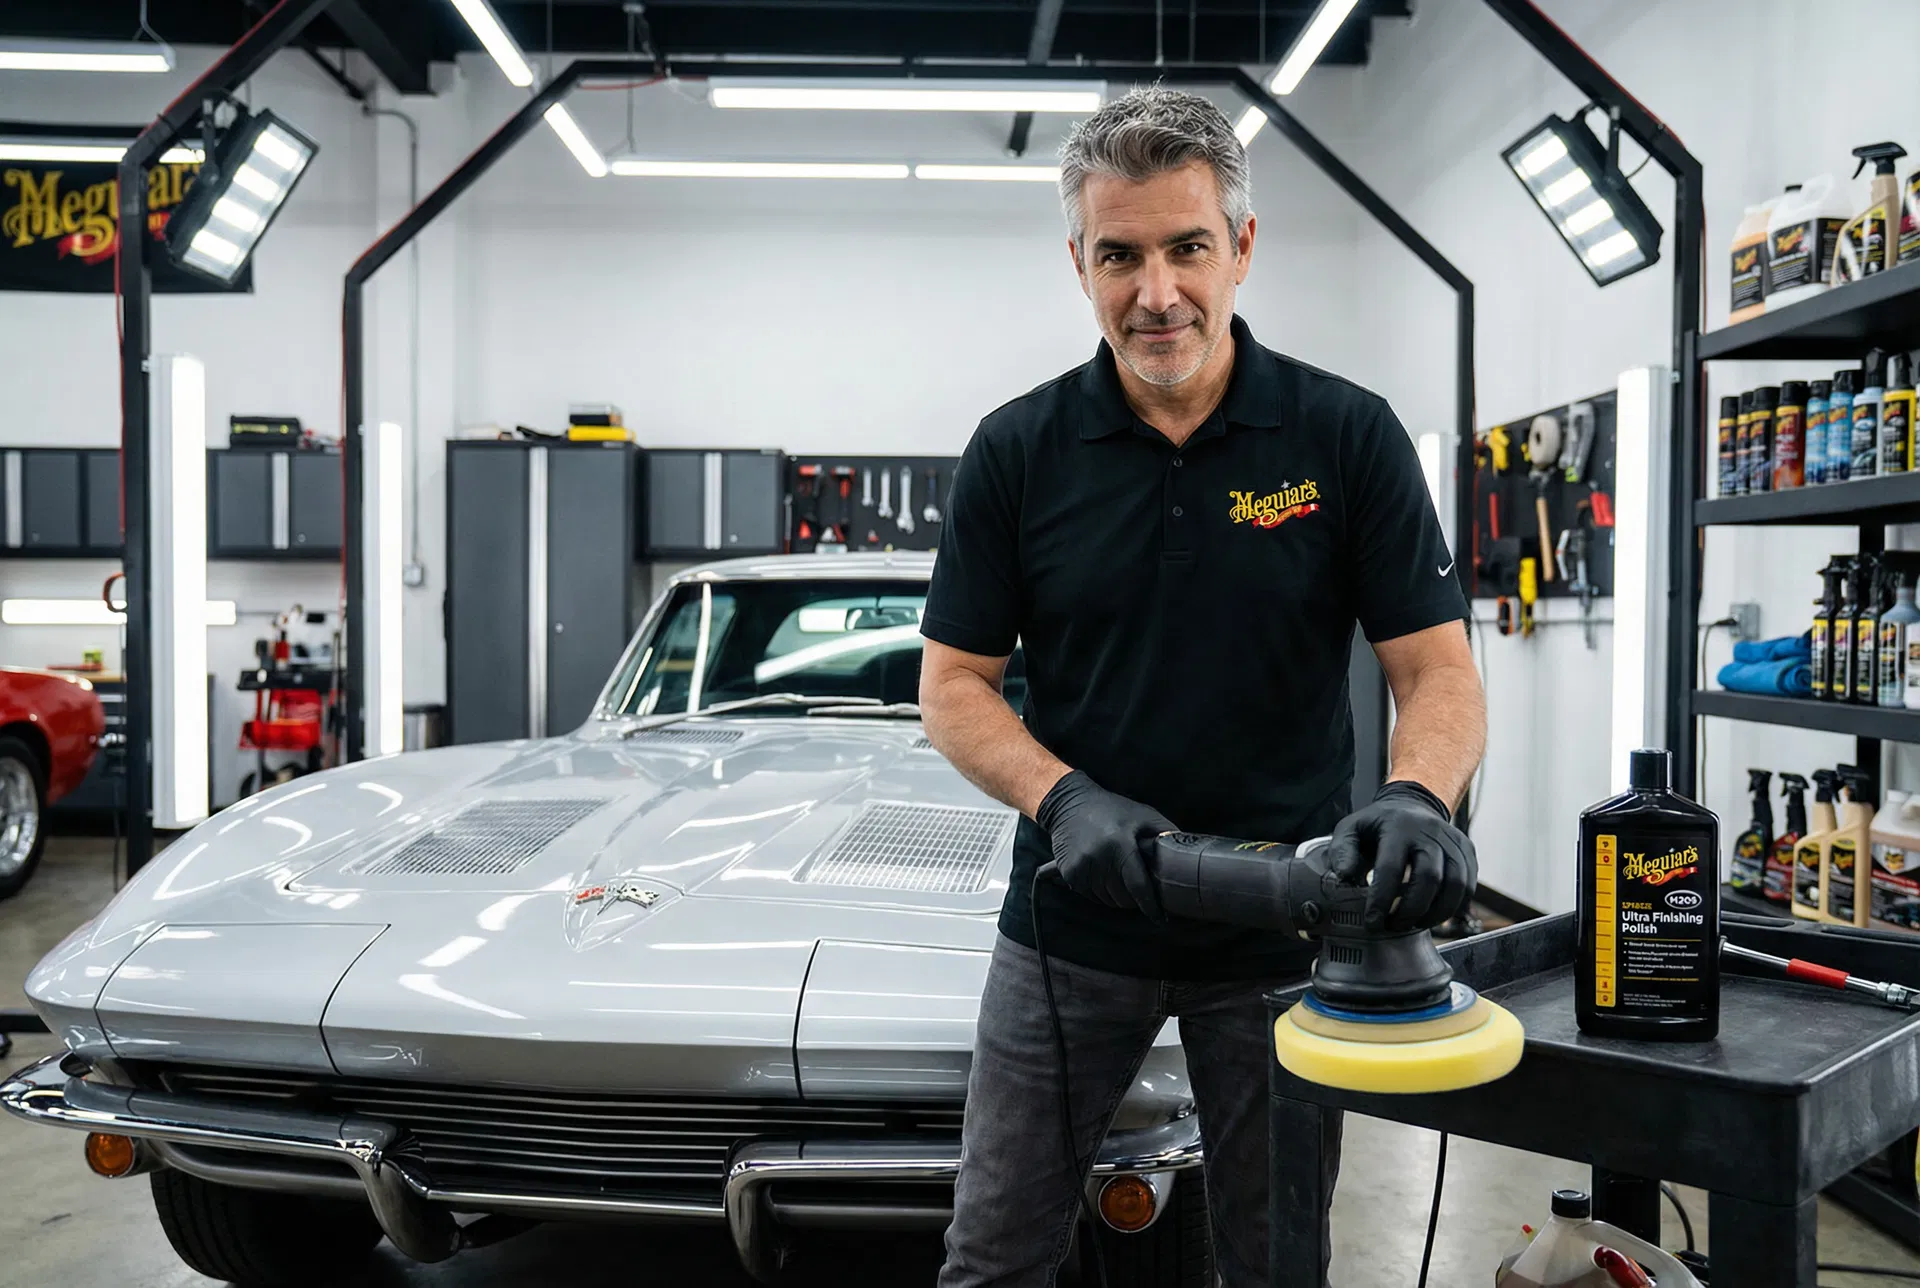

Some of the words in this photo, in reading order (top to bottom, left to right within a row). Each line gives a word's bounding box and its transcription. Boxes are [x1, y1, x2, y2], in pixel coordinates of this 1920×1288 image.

[1229, 479, 1318, 526] Meguiar's
[1623, 845, 1698, 884] Meguiar's
[1622, 911, 1650, 922] Ultra
[1652, 912, 1704, 925] Finishing
[1622, 922, 1658, 934] Polish
